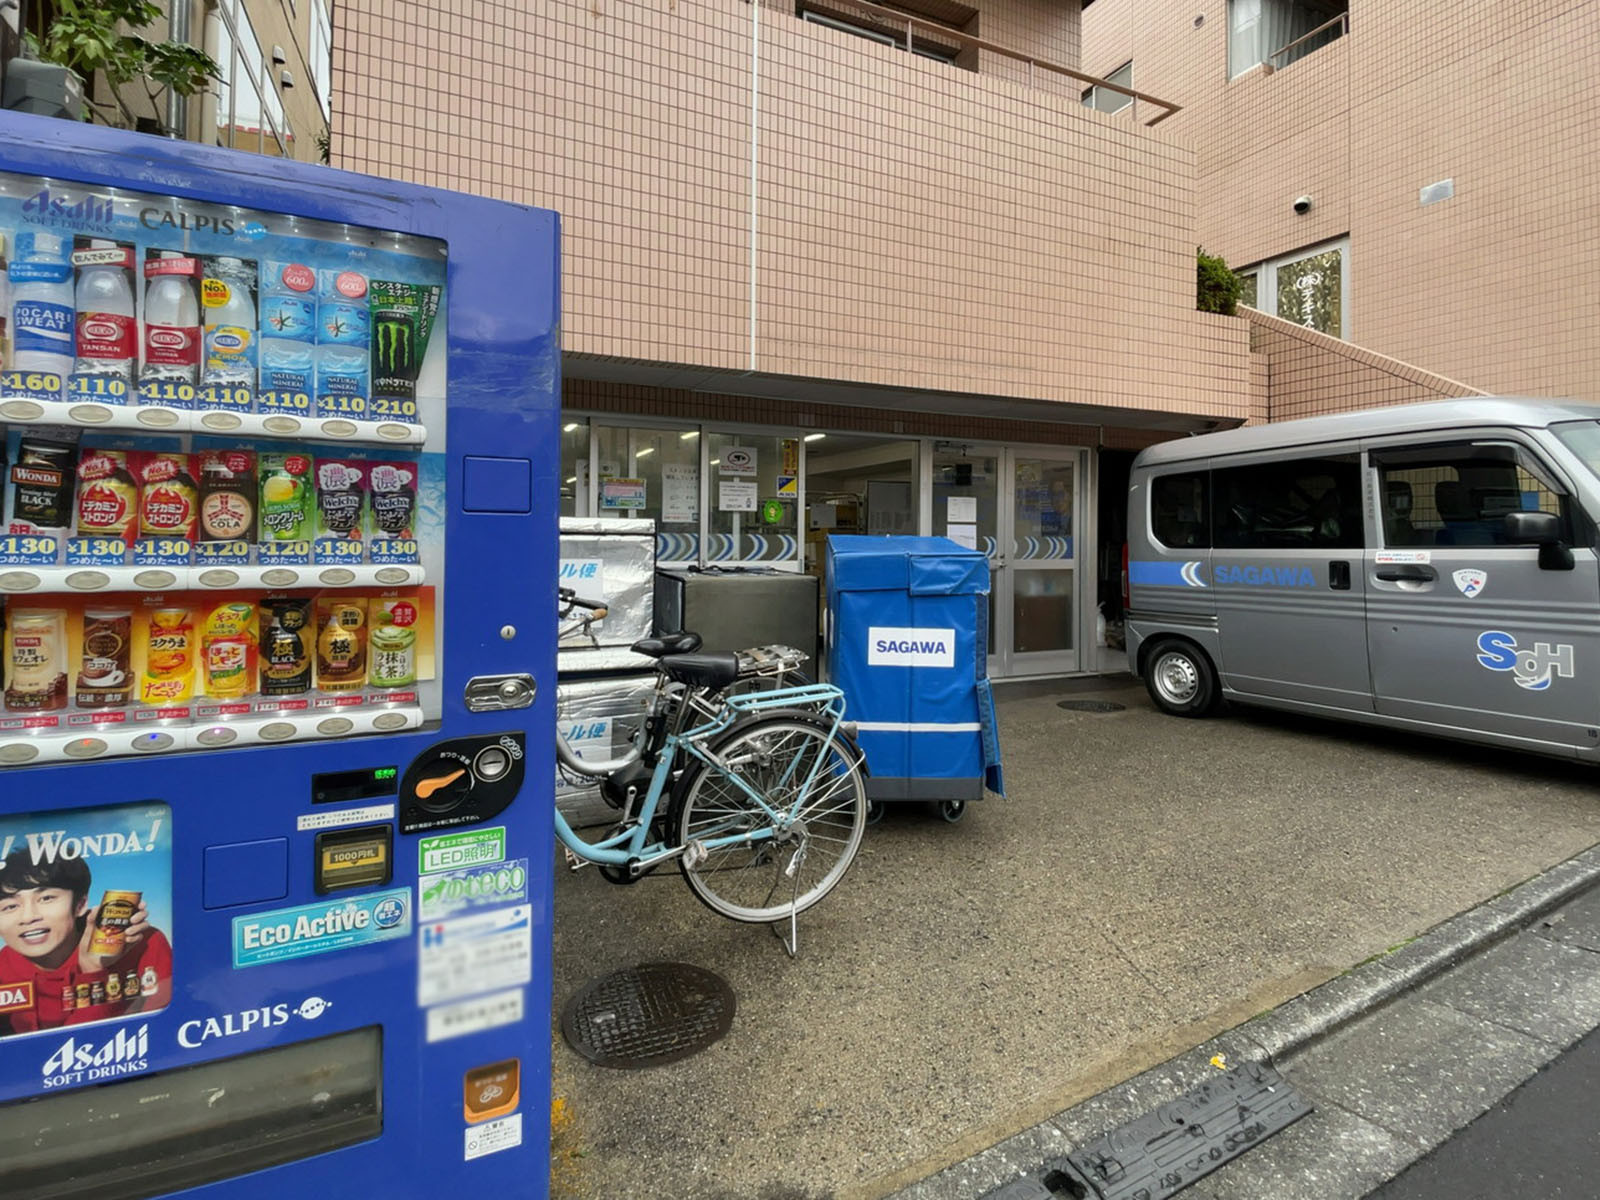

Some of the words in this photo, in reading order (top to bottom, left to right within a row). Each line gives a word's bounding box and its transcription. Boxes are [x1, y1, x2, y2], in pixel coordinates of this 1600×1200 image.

[21, 190, 114, 223] Asahi
[139, 207, 235, 235] CALPIS
[1, 374, 61, 391] ¥160
[68, 378, 125, 396] ¥110
[139, 383, 195, 401] ¥110
[197, 389, 250, 405] ¥110
[258, 391, 309, 409] ¥110
[317, 396, 365, 412] ¥110
[370, 399, 416, 416] ¥210
[14, 467, 58, 484] WONDA
[210, 520, 241, 529] COLA
[67, 540, 126, 556] ¥130
[134, 540, 191, 556] ¥130
[195, 541, 249, 556] ¥120
[259, 541, 310, 556] ¥120
[315, 541, 363, 556] ¥130
[371, 540, 417, 555] ¥130
[1214, 566, 1317, 588] SAGAWA
[150, 638, 186, 648] コクうま
[876, 640, 947, 655] SAGAWA
[25, 819, 162, 866] WONDA!
[333, 849, 376, 861] 1000円札
[429, 843, 496, 867] LED照明
[176, 1003, 290, 1048] CALPIS
[41, 1023, 148, 1076] Asahi
[43, 1072, 84, 1089] SOFT
[88, 1058, 148, 1082] DRINKS
